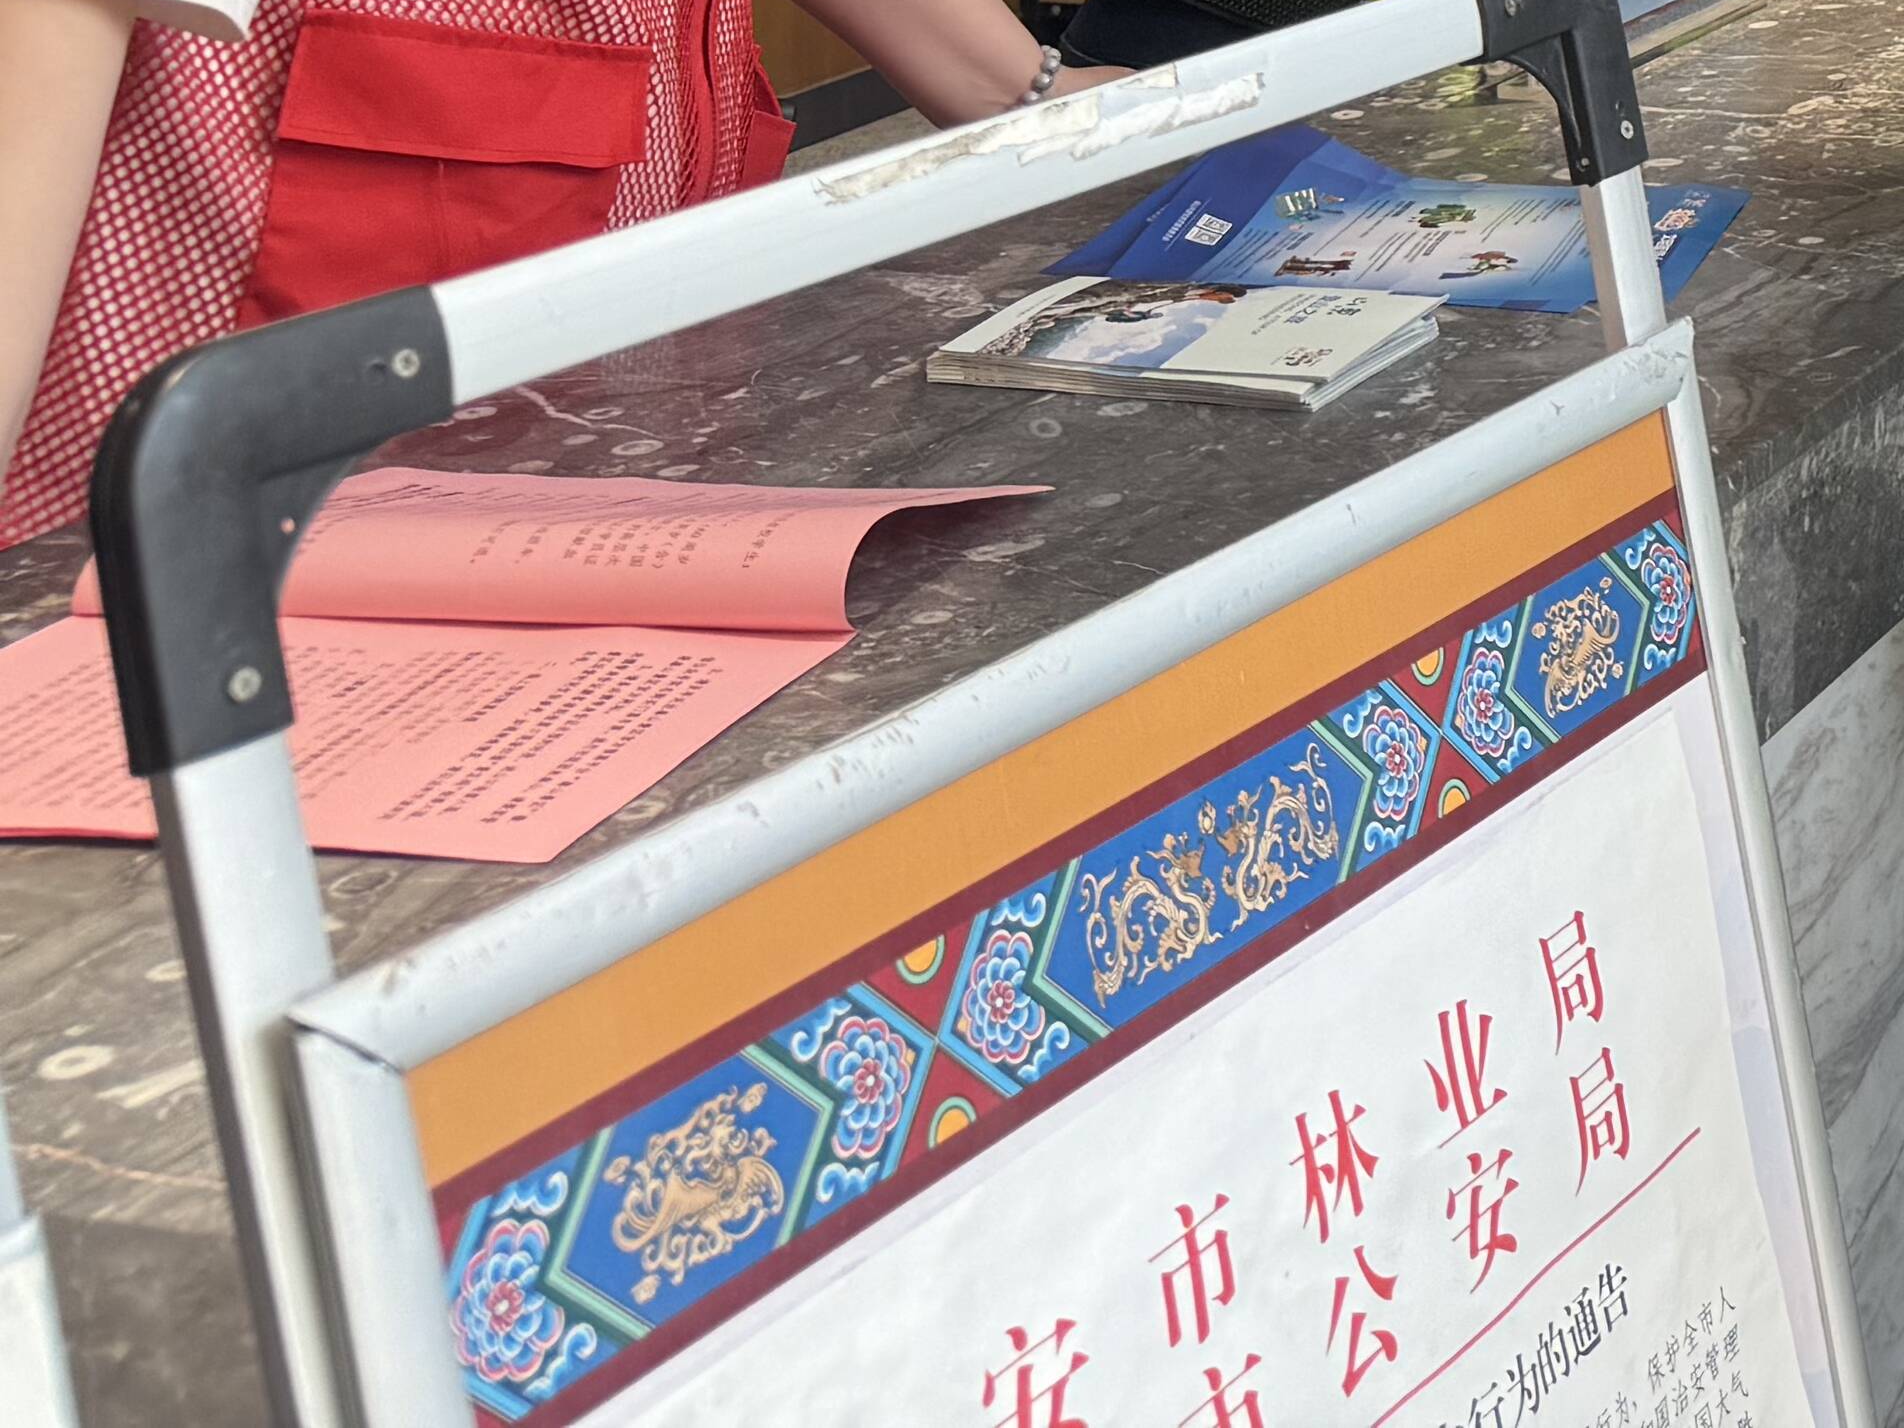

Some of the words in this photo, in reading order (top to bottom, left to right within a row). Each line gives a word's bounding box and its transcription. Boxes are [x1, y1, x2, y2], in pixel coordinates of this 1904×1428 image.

[1438, 1263, 1629, 1428] 行为的通告
[1641, 1323, 1741, 1428] 国治安管理
